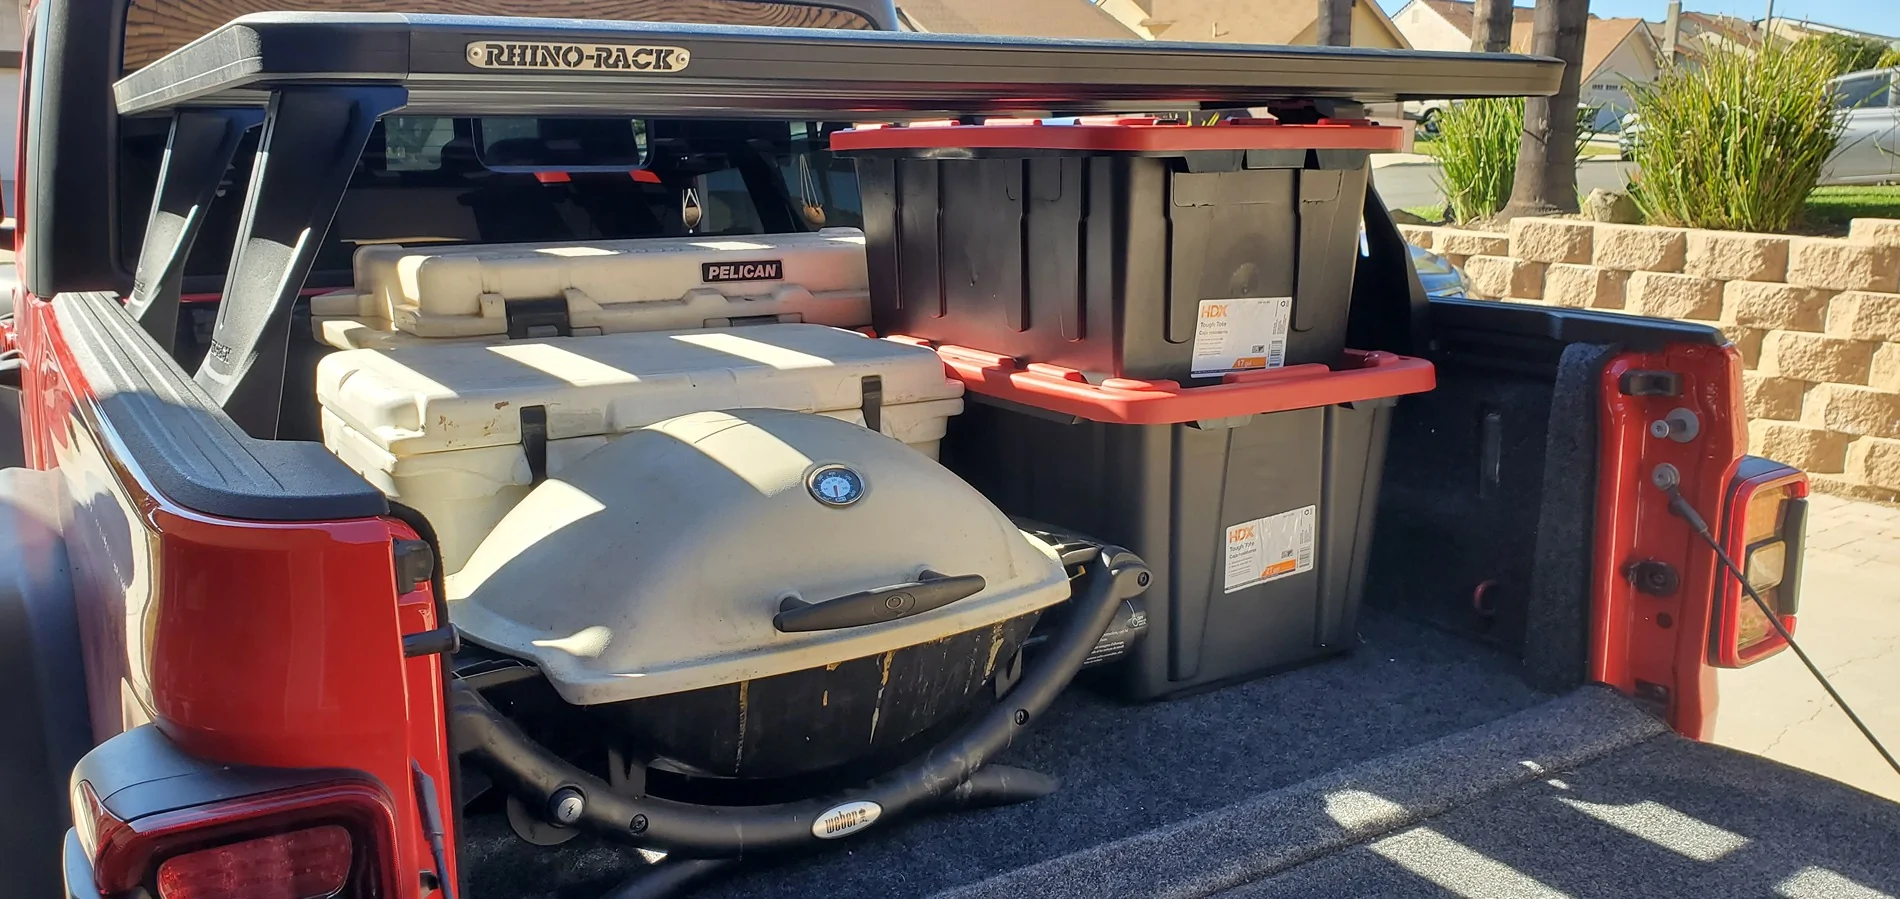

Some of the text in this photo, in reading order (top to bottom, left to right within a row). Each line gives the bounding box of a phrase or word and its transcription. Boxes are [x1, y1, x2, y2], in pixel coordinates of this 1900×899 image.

[485, 44, 675, 70] RHINO-RACK
[708, 264, 777, 280] PELICAN
[1201, 304, 1228, 318] HDX
[1229, 525, 1256, 543] HDX
[825, 810, 857, 834] weber
